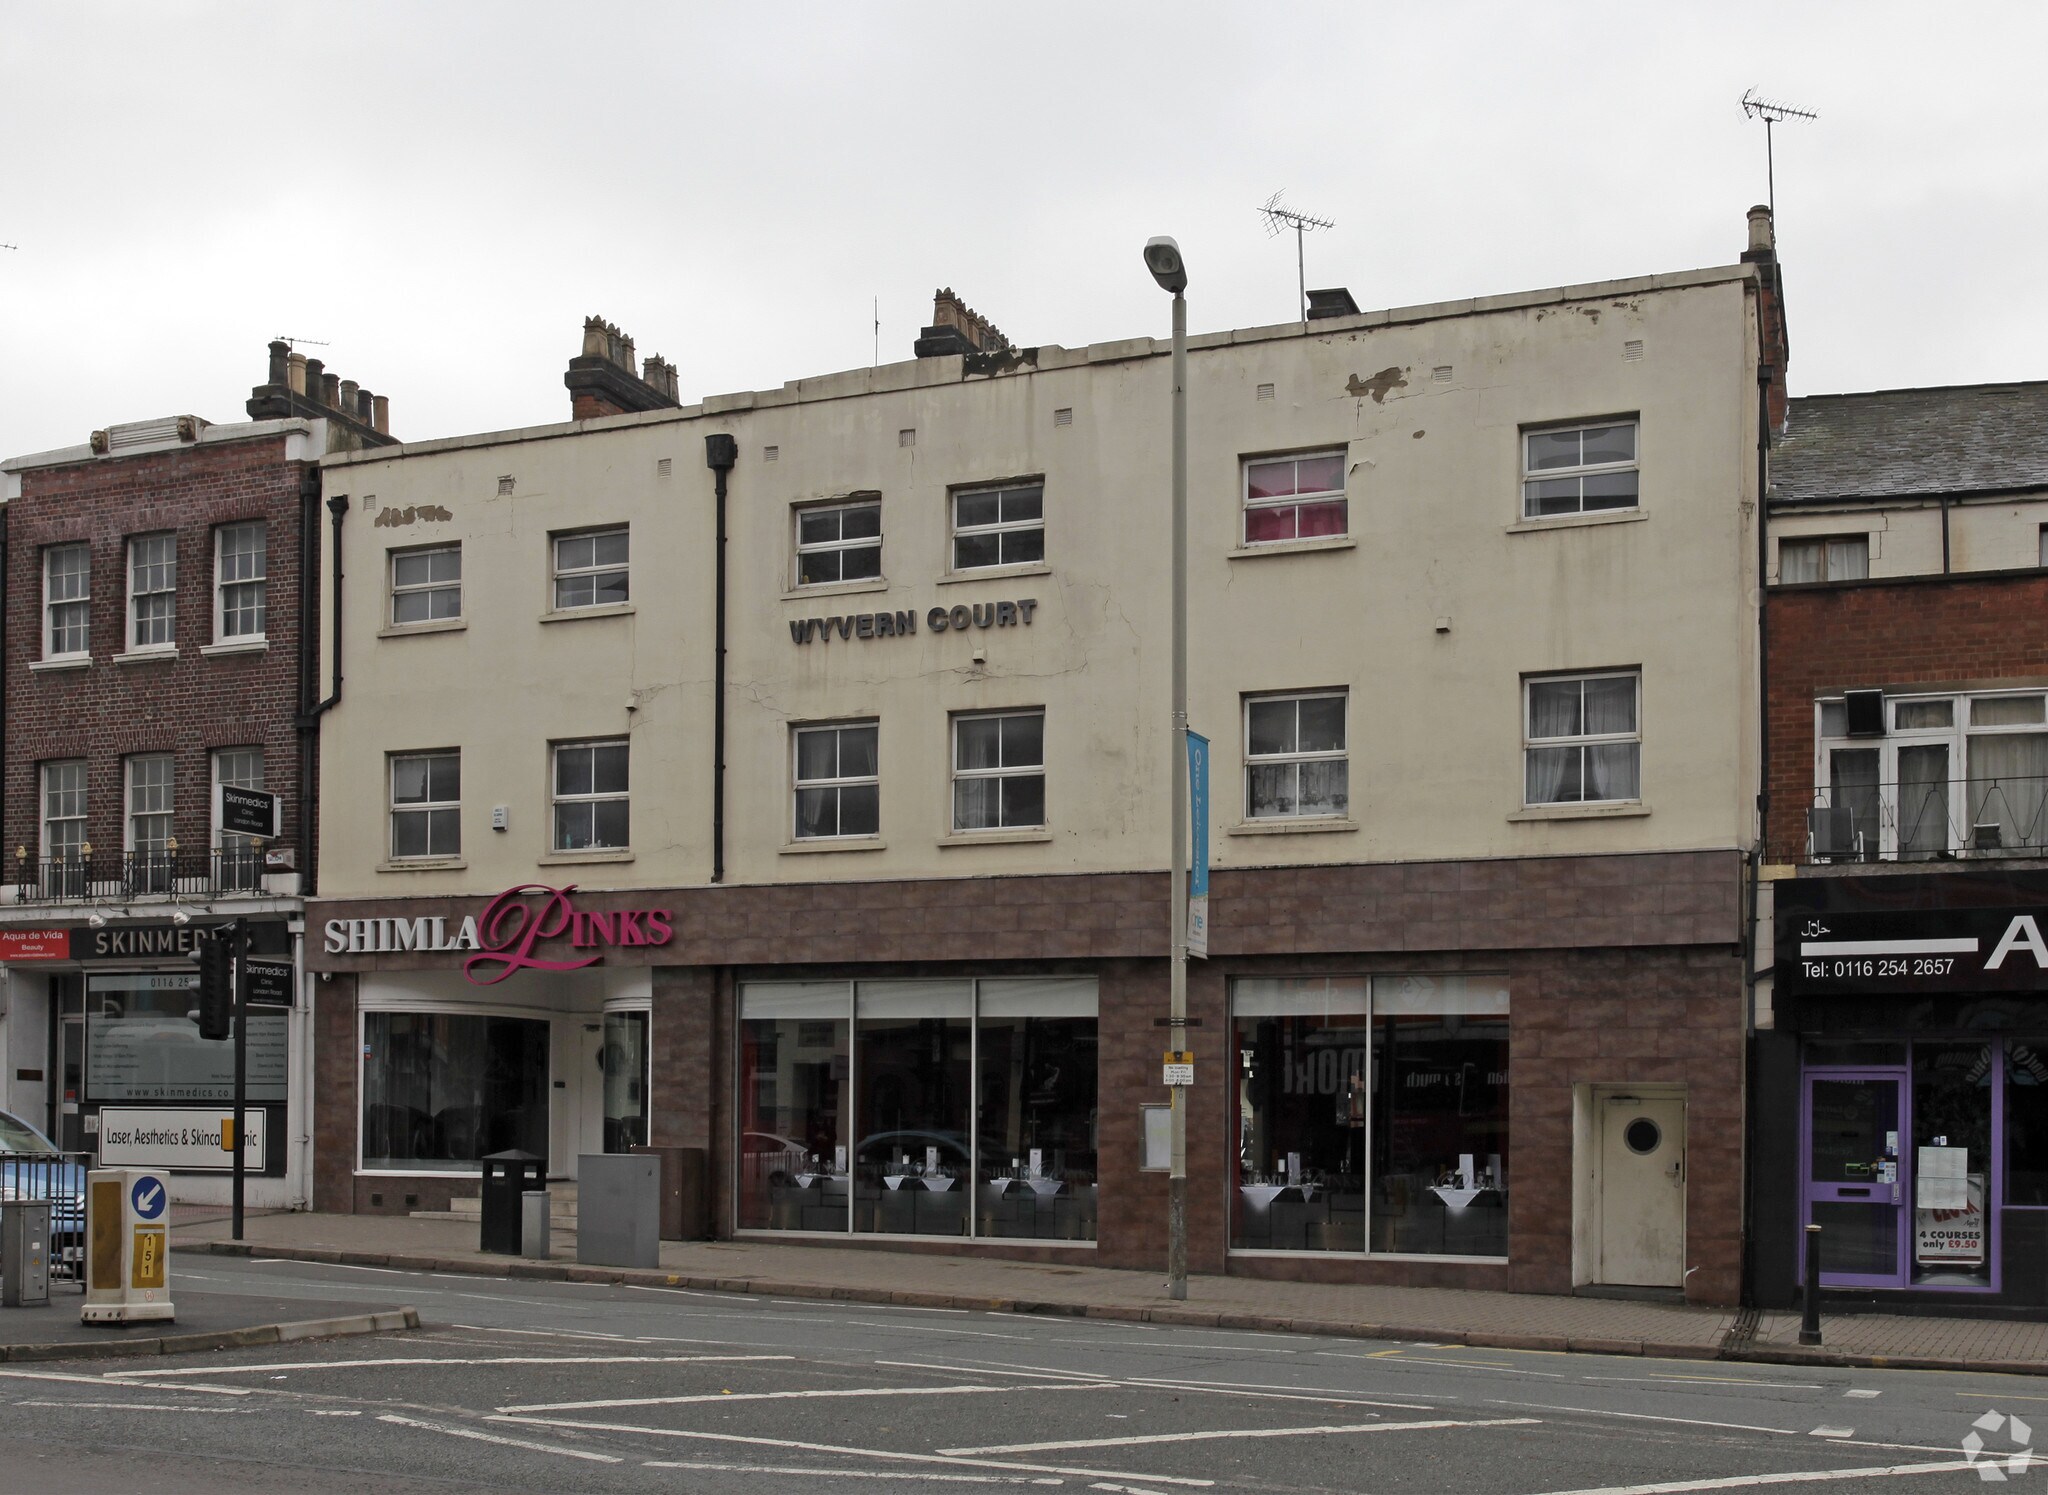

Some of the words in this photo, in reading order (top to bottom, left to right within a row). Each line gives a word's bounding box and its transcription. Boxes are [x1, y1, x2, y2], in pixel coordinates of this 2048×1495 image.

[789, 609, 917, 644] WYVERN
[927, 598, 1037, 633] COURT
[1194, 748, 1203, 790] One
[233, 816, 250, 825] London
[250, 819, 264, 828] Road
[2, 932, 26, 941] Aqua
[28, 931, 40, 940] de
[43, 930, 63, 939] Vida
[324, 915, 481, 953] SHIMLA
[463, 884, 673, 986] PINKS
[1801, 919, 1831, 937] حلال
[1802, 962, 1829, 977] Tel:
[1834, 960, 1873, 977] 0116
[1878, 960, 1908, 976] 254
[1913, 958, 1954, 975] 2657
[150, 977, 174, 987] 0116
[107, 1127, 132, 1147] Laser,
[134, 1127, 179, 1146] Aesthetics
[181, 1128, 189, 1146] &
[191, 1128, 221, 1146] Skinca
[1919, 1230, 1927, 1239] 4
[1930, 1231, 1981, 1239] COURSES
[1922, 1239, 1945, 1250] only
[1948, 1240, 1977, 1249] £9.50
